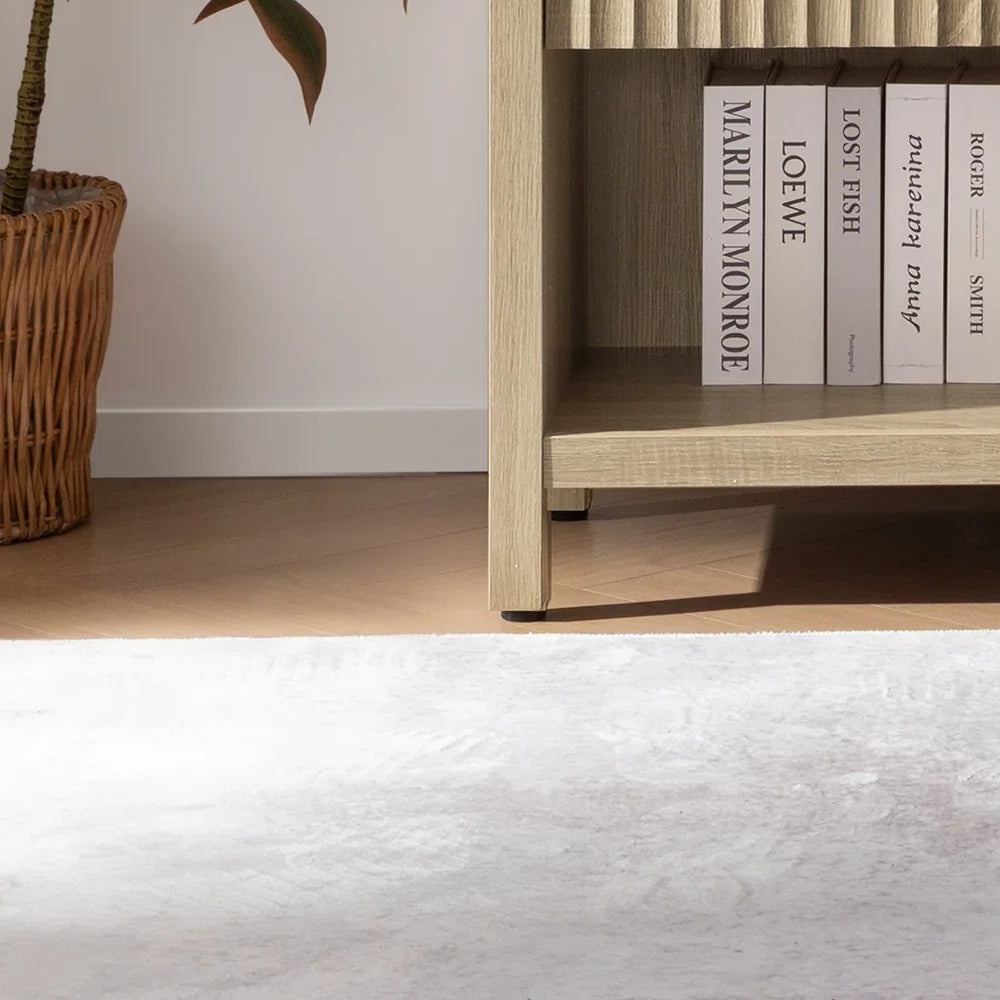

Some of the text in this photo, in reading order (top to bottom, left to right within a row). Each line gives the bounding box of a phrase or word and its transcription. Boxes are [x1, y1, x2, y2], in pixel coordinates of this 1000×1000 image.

[720, 100, 752, 373] MARILYN MONROE
[781, 140, 807, 244] LOEWE
[842, 108, 861, 235] LOST FISH
[900, 134, 923, 334] Anna karenina
[969, 132, 985, 335] ROGER SMITH
